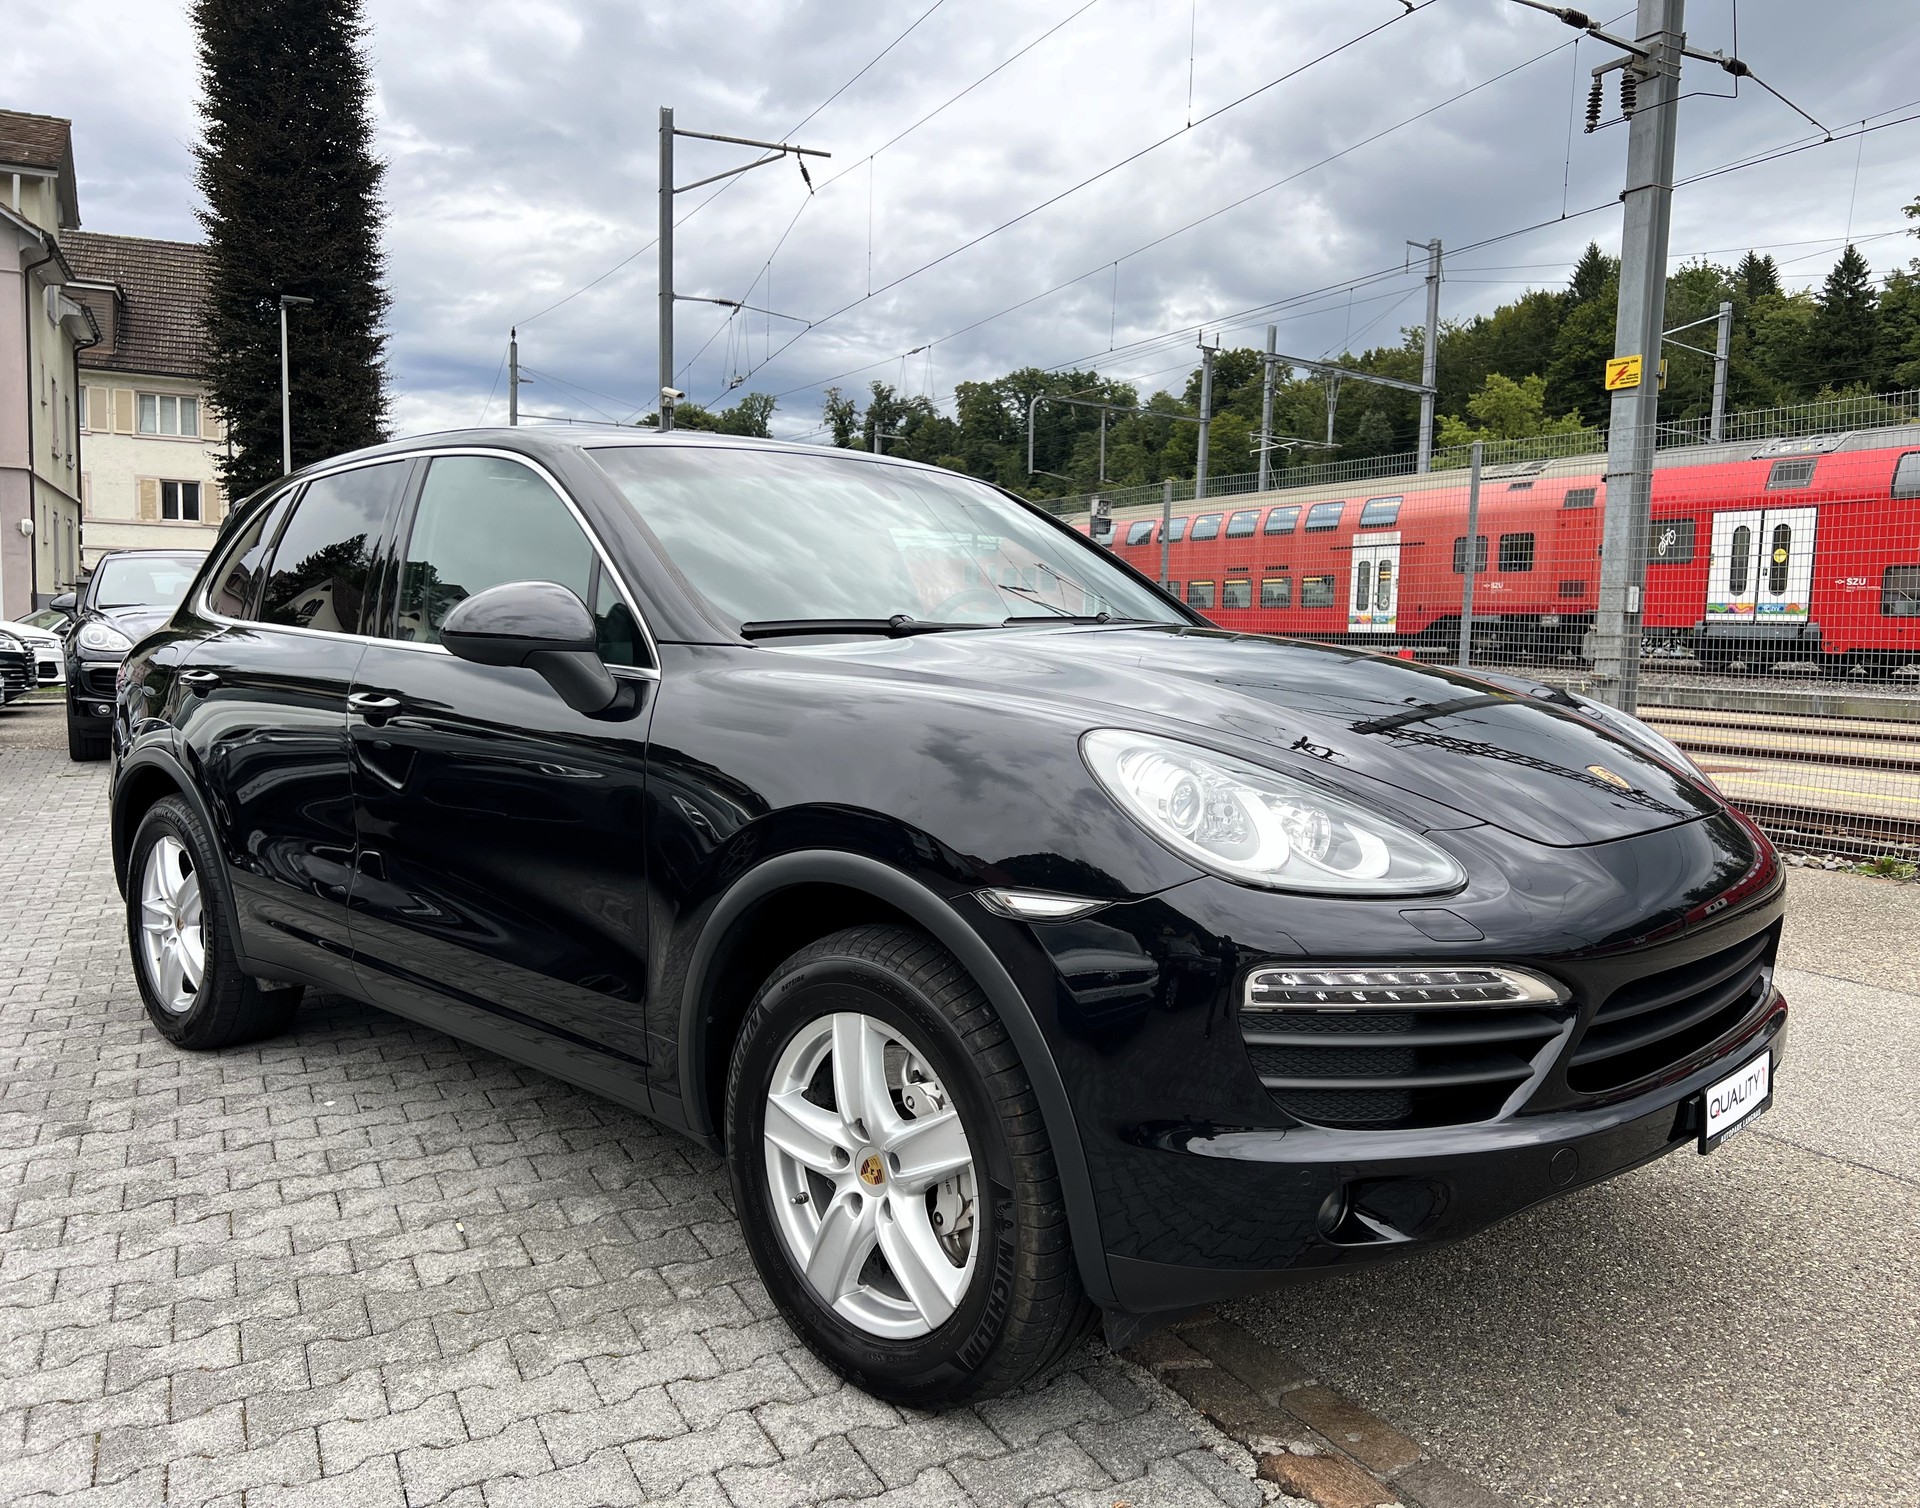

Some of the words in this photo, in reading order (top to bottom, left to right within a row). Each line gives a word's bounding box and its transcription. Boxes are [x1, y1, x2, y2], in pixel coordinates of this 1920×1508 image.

[1846, 577, 1866, 585] SZU
[728, 1007, 761, 1125] MICHELIN
[962, 1239, 1017, 1367] MICHELIN
